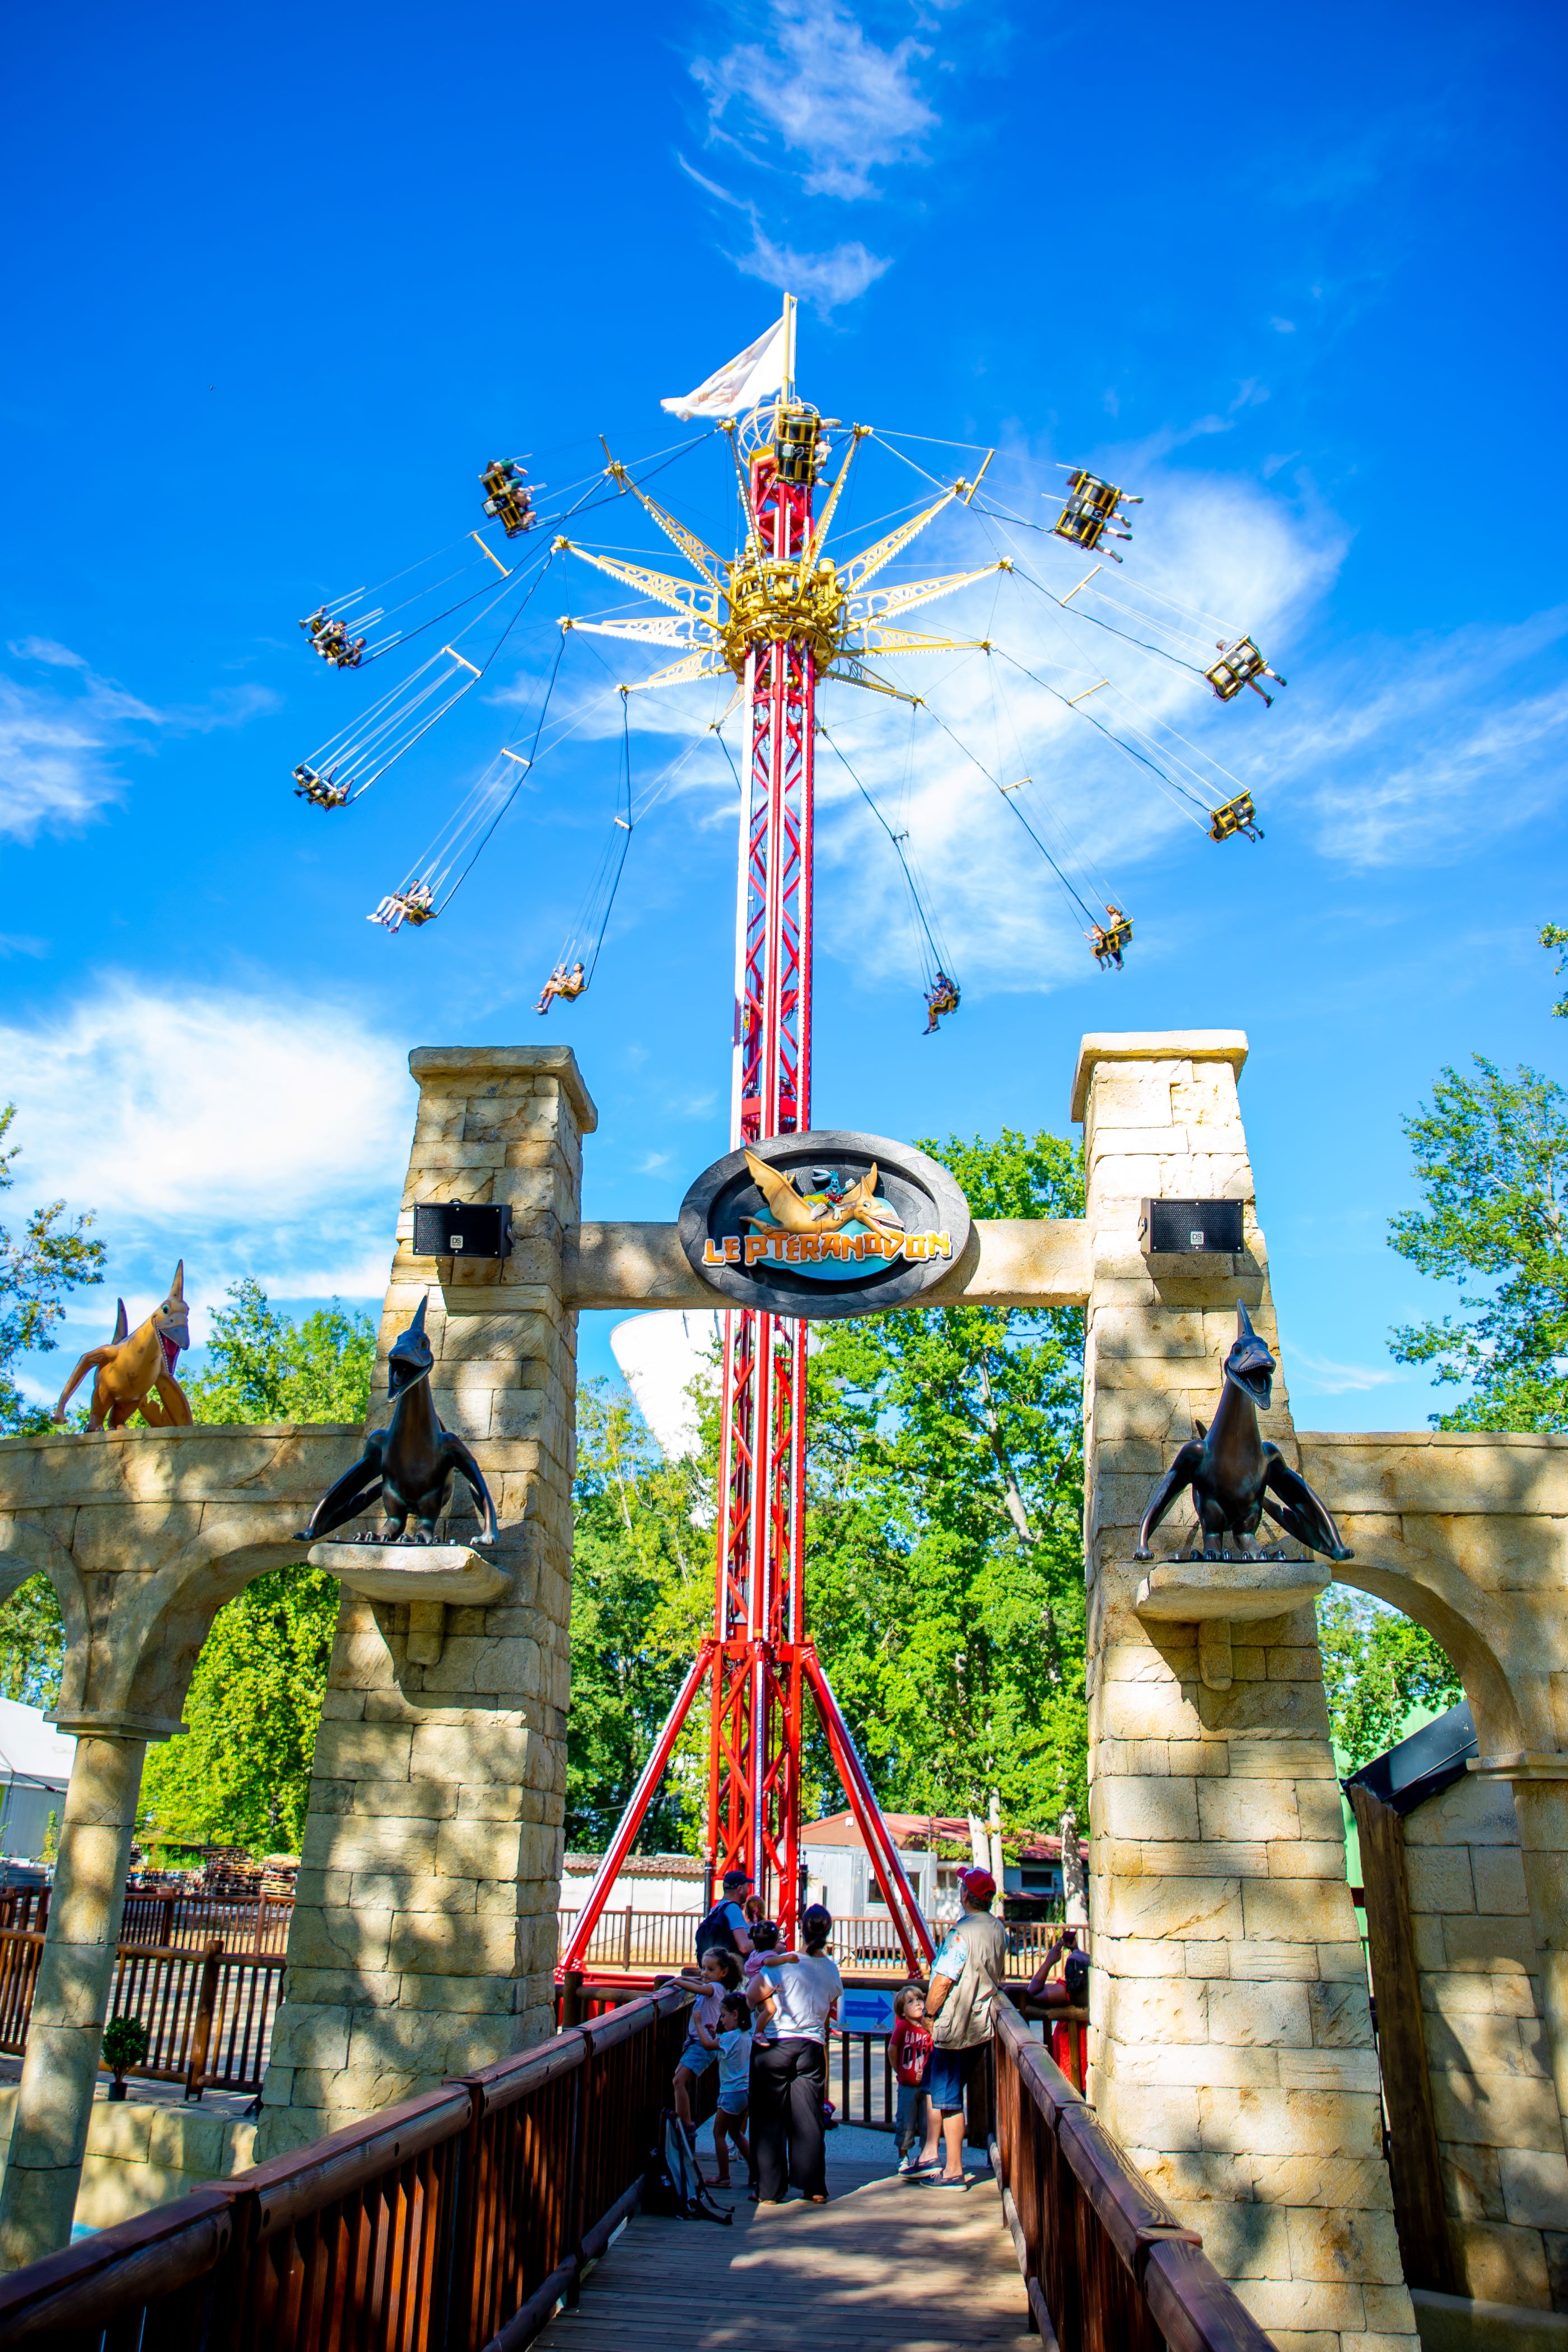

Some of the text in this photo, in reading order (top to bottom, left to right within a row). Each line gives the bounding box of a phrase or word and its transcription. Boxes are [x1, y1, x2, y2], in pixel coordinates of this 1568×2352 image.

[703, 1231, 950, 1264] LE PTÉRANODON
[905, 2031, 927, 2046] GAME
